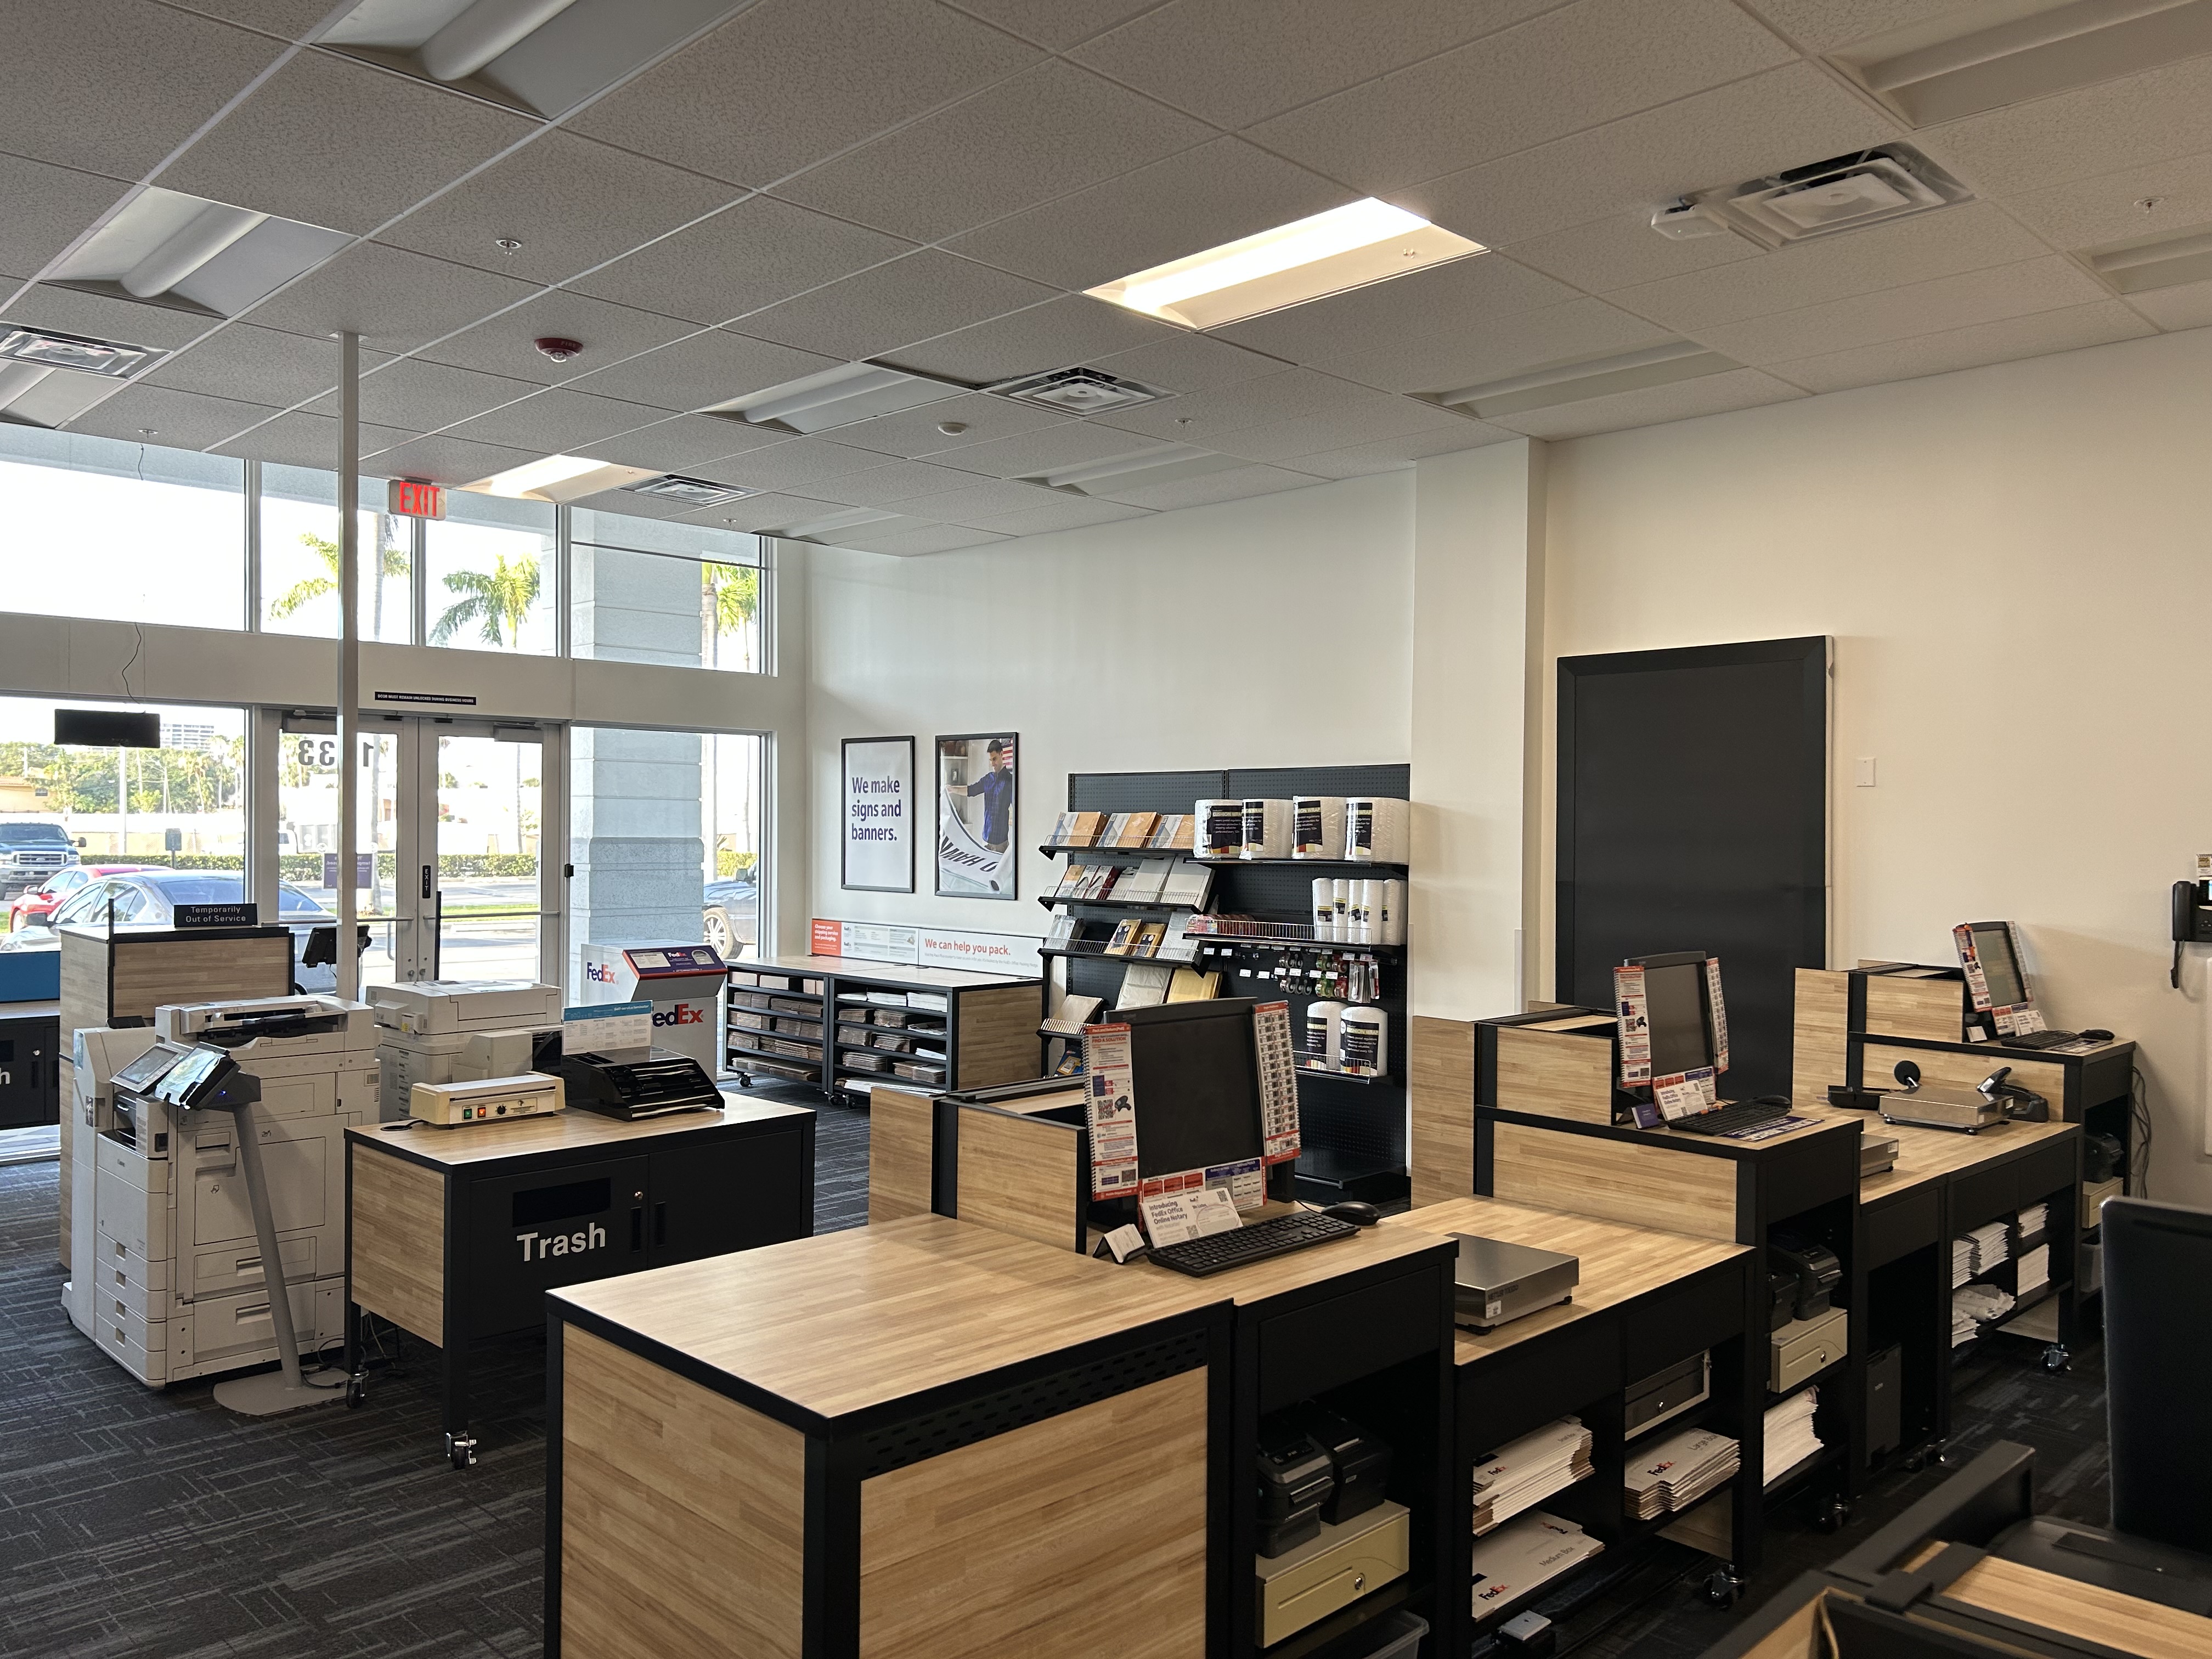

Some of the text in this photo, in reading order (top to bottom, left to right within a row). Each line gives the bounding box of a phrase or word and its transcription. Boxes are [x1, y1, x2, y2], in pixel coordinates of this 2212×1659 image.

[399, 482, 440, 517] EXIT
[851, 775, 900, 793] We make
[851, 799, 901, 822] signs and
[851, 823, 898, 841] banners.
[190, 906, 241, 914] Temporarily
[925, 938, 1011, 956] We can help you pack.
[586, 962, 615, 984] FedEx
[652, 1003, 704, 1027] edEx
[1149, 1200, 1178, 1210] Introducing
[1167, 1207, 1183, 1215] Office
[1154, 1213, 1188, 1224] Online Notary
[516, 1222, 605, 1262] Trash
[1688, 1438, 1706, 1451] Large
[1487, 1466, 1507, 1476] FedEx
[1647, 1461, 1675, 1476] FedEx
[1539, 1547, 1576, 1567] Medium Box
[1479, 1584, 1508, 1600] FedEx
